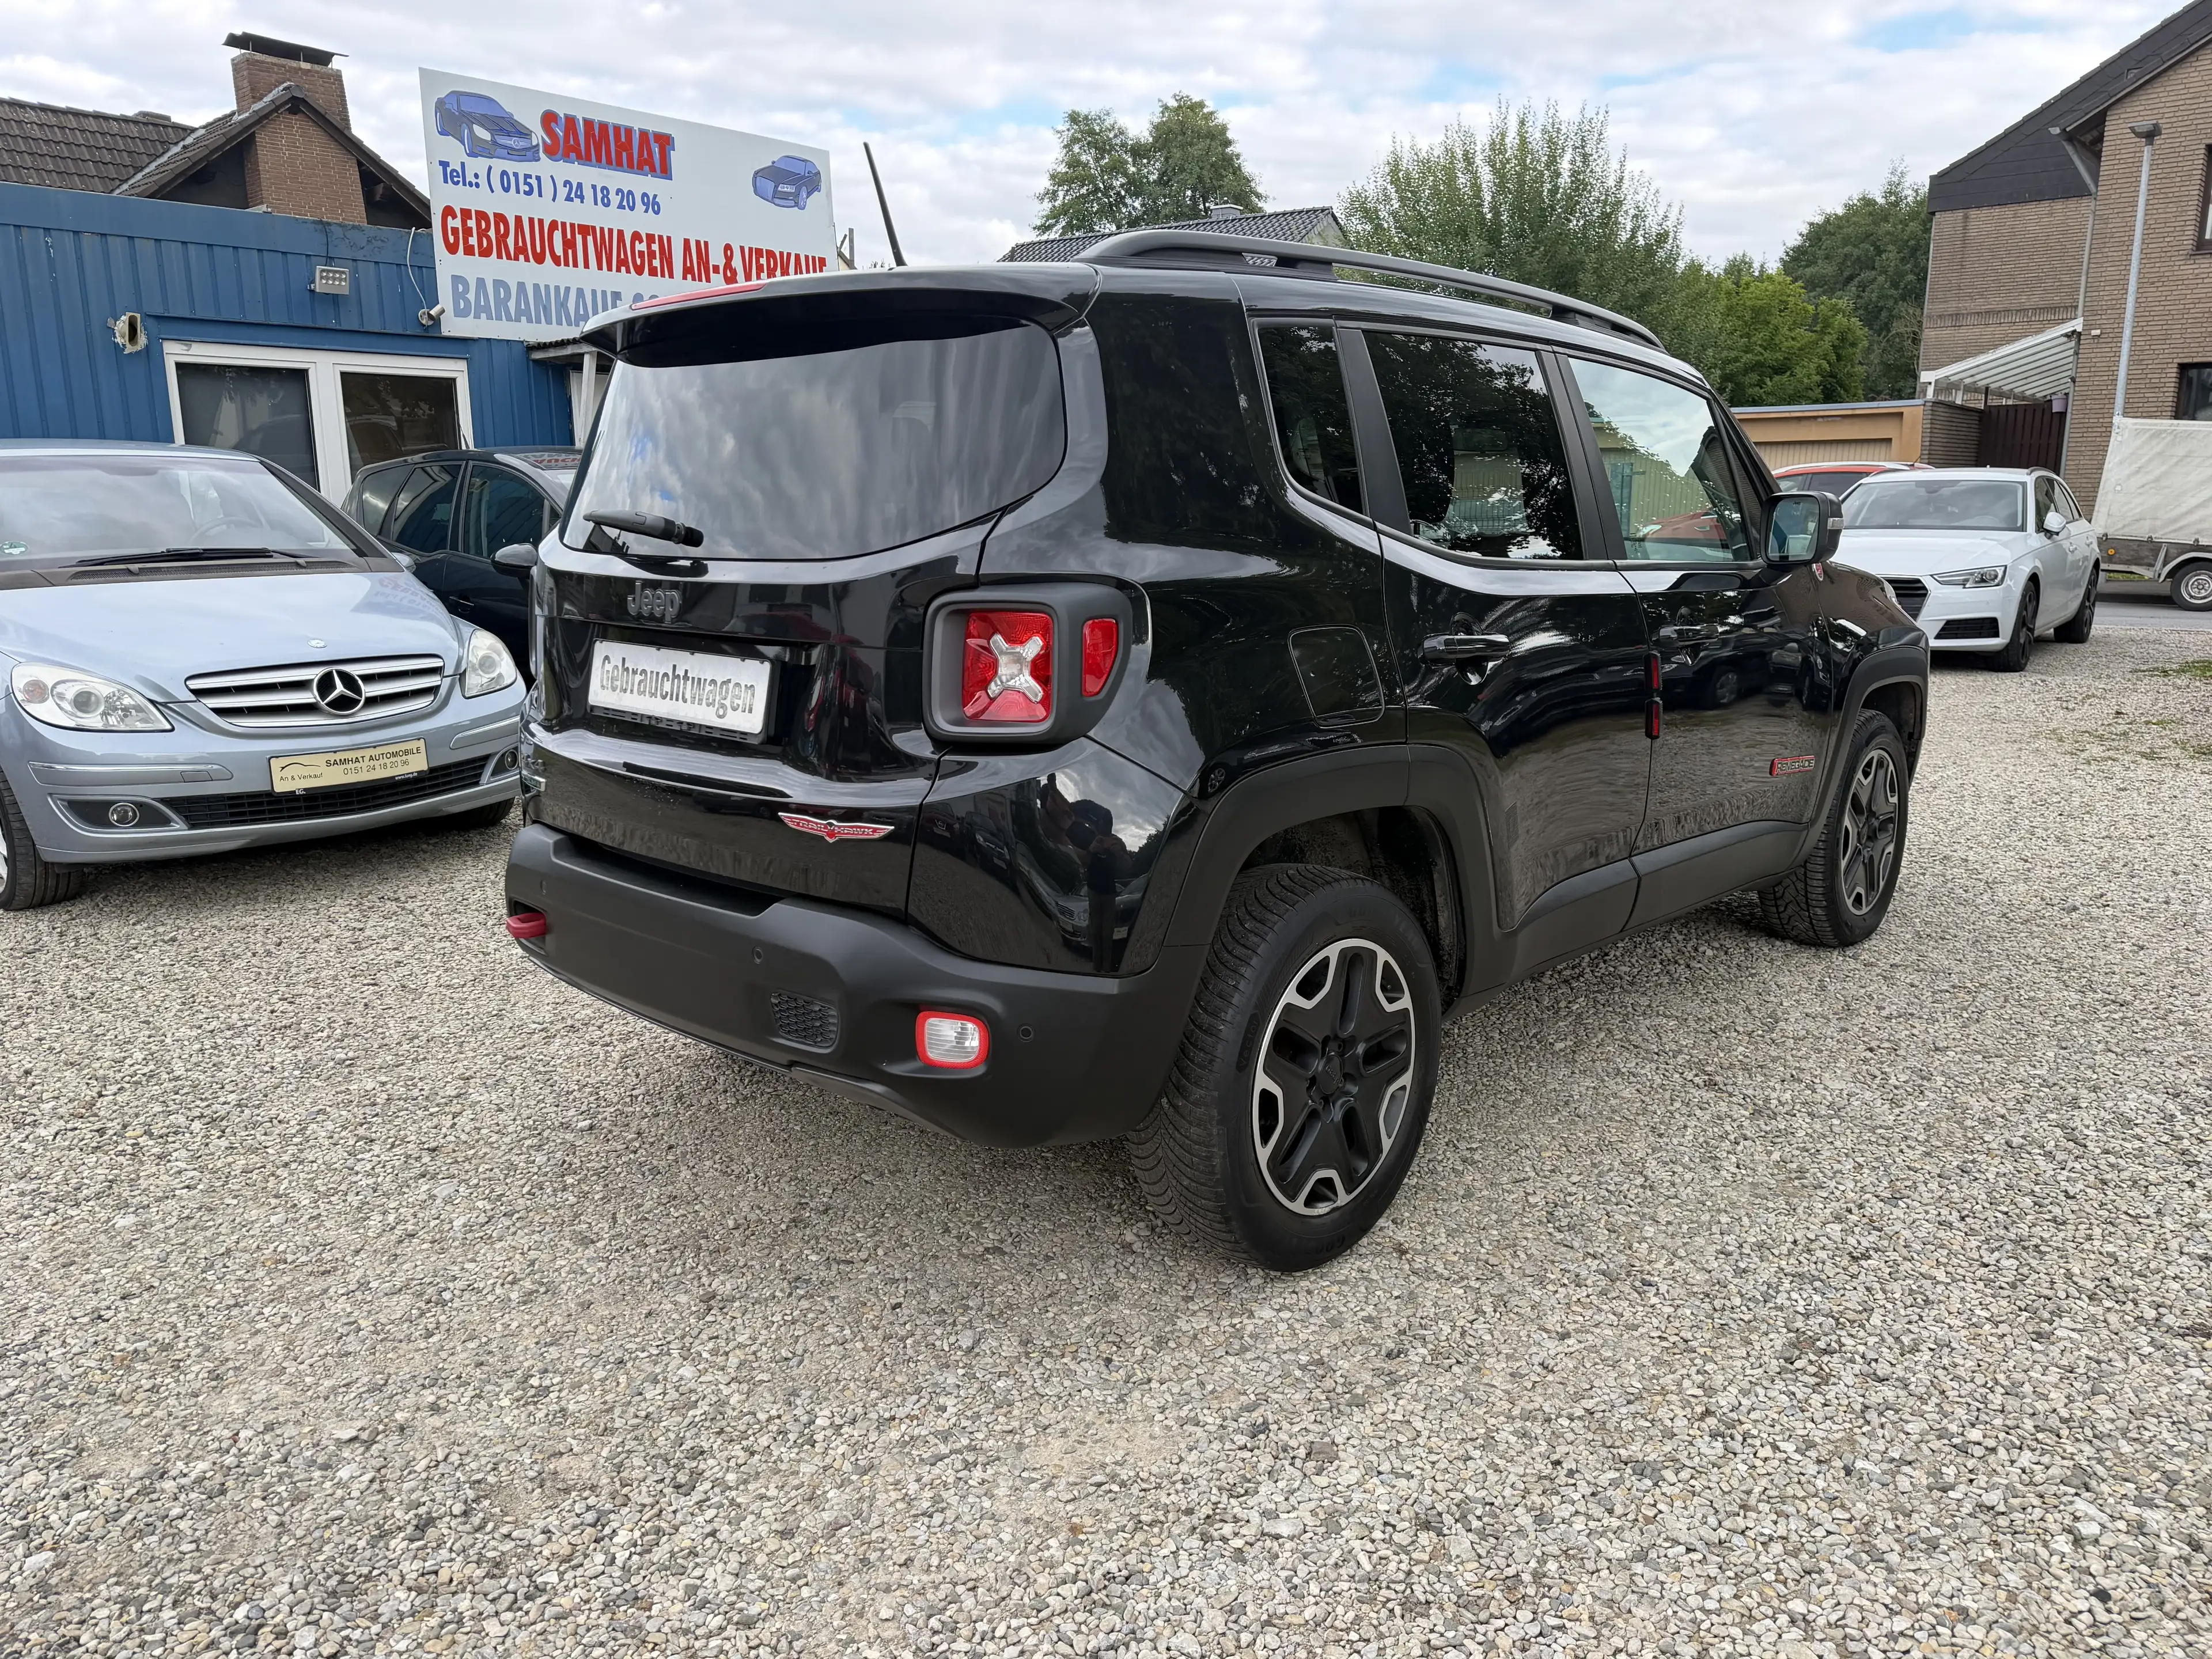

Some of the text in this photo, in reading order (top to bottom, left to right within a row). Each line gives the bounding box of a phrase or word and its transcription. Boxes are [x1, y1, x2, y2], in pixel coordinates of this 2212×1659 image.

[540, 109, 675, 180] SAMHAT
[438, 160, 479, 189] Tel.:
[563, 179, 585, 203] 24
[591, 184, 611, 208] 18
[615, 188, 636, 211] 20
[641, 191, 661, 215] 96
[441, 204, 675, 279] GEBRAUCHTWAGEN
[627, 580, 682, 624] Jeep
[600, 654, 756, 719] Gebrauchtwagen
[297, 772, 323, 780] Verkauf
[325, 747, 422, 767] SAMHAT AUTOMOBILE
[343, 767, 363, 775] 0151
[390, 760, 399, 769] 20
[400, 759, 409, 767] 96
[1777, 758, 1814, 772] RENEGADE
